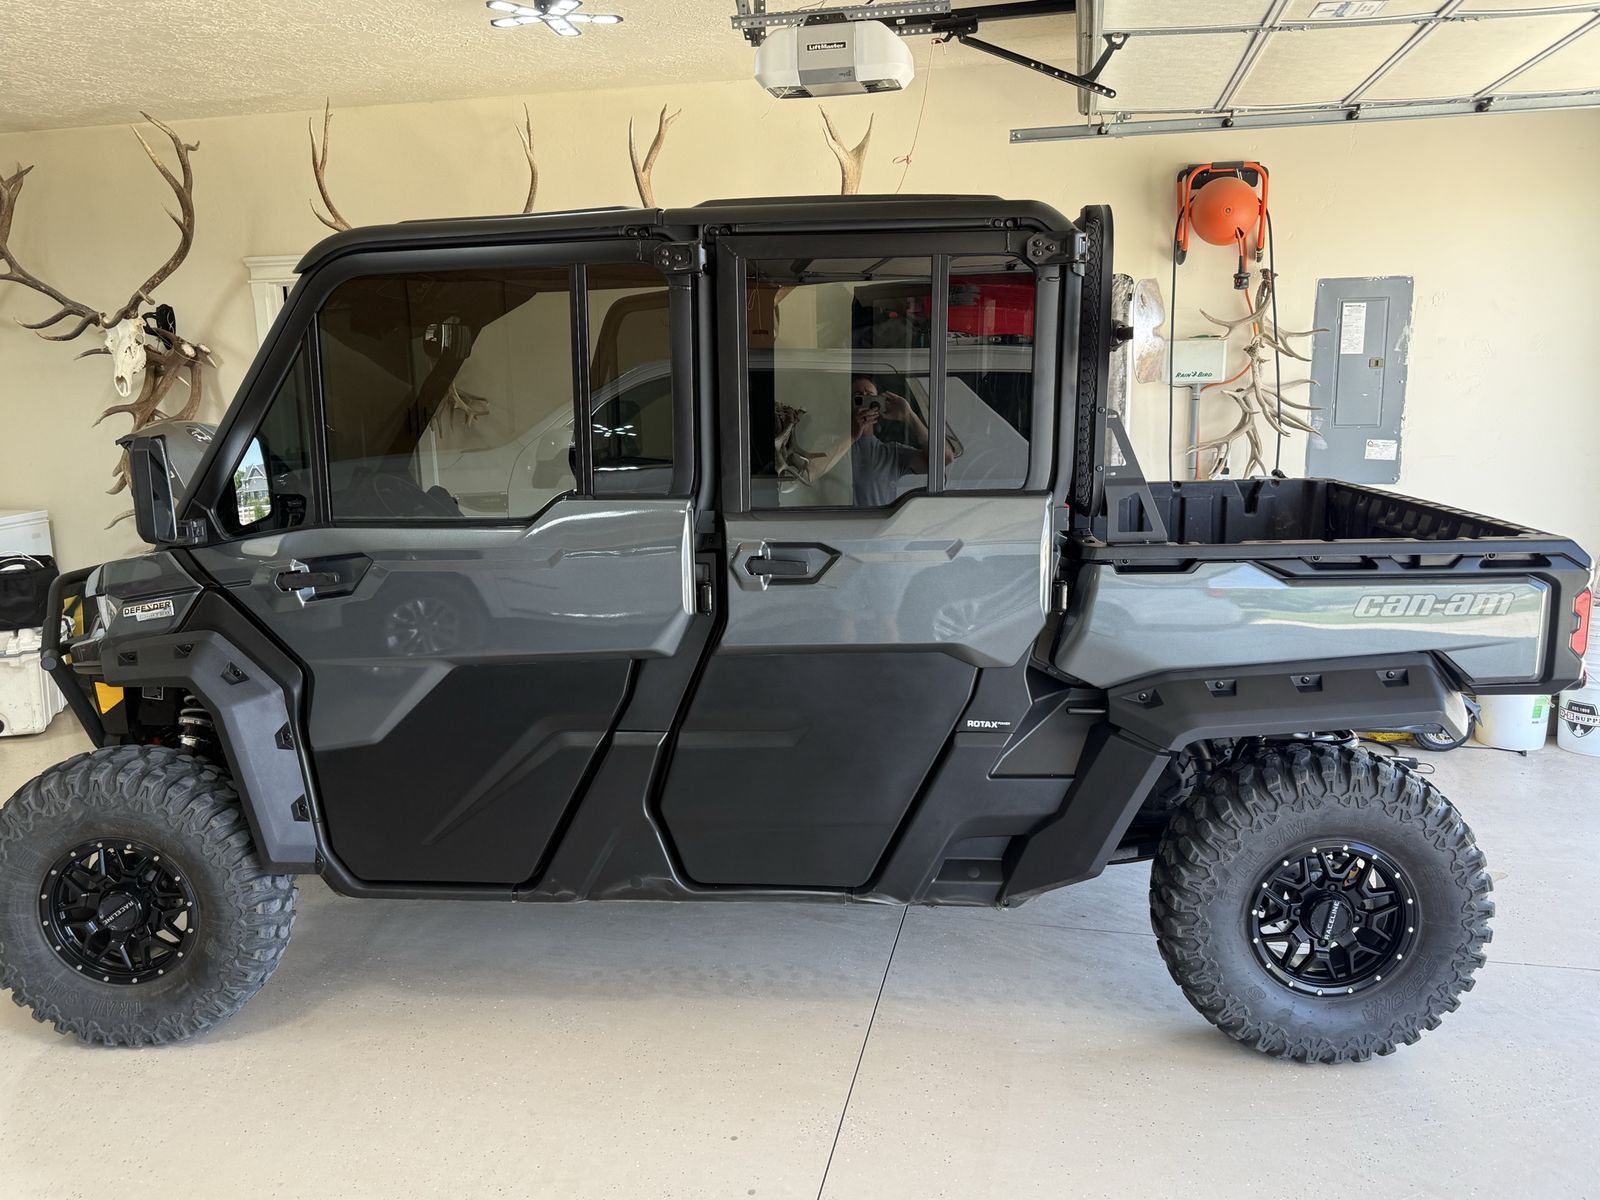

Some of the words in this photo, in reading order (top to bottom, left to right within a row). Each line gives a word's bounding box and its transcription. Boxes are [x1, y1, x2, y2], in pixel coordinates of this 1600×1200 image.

[808, 42, 846, 50] LiftMaster
[123, 601, 171, 615] DEFENDER
[1353, 592, 1515, 618] can-am
[967, 720, 998, 728] ROTAX
[1575, 715, 1600, 723] SUPP
[102, 900, 134, 925] RACELINE
[1324, 900, 1340, 940] RACELINE
